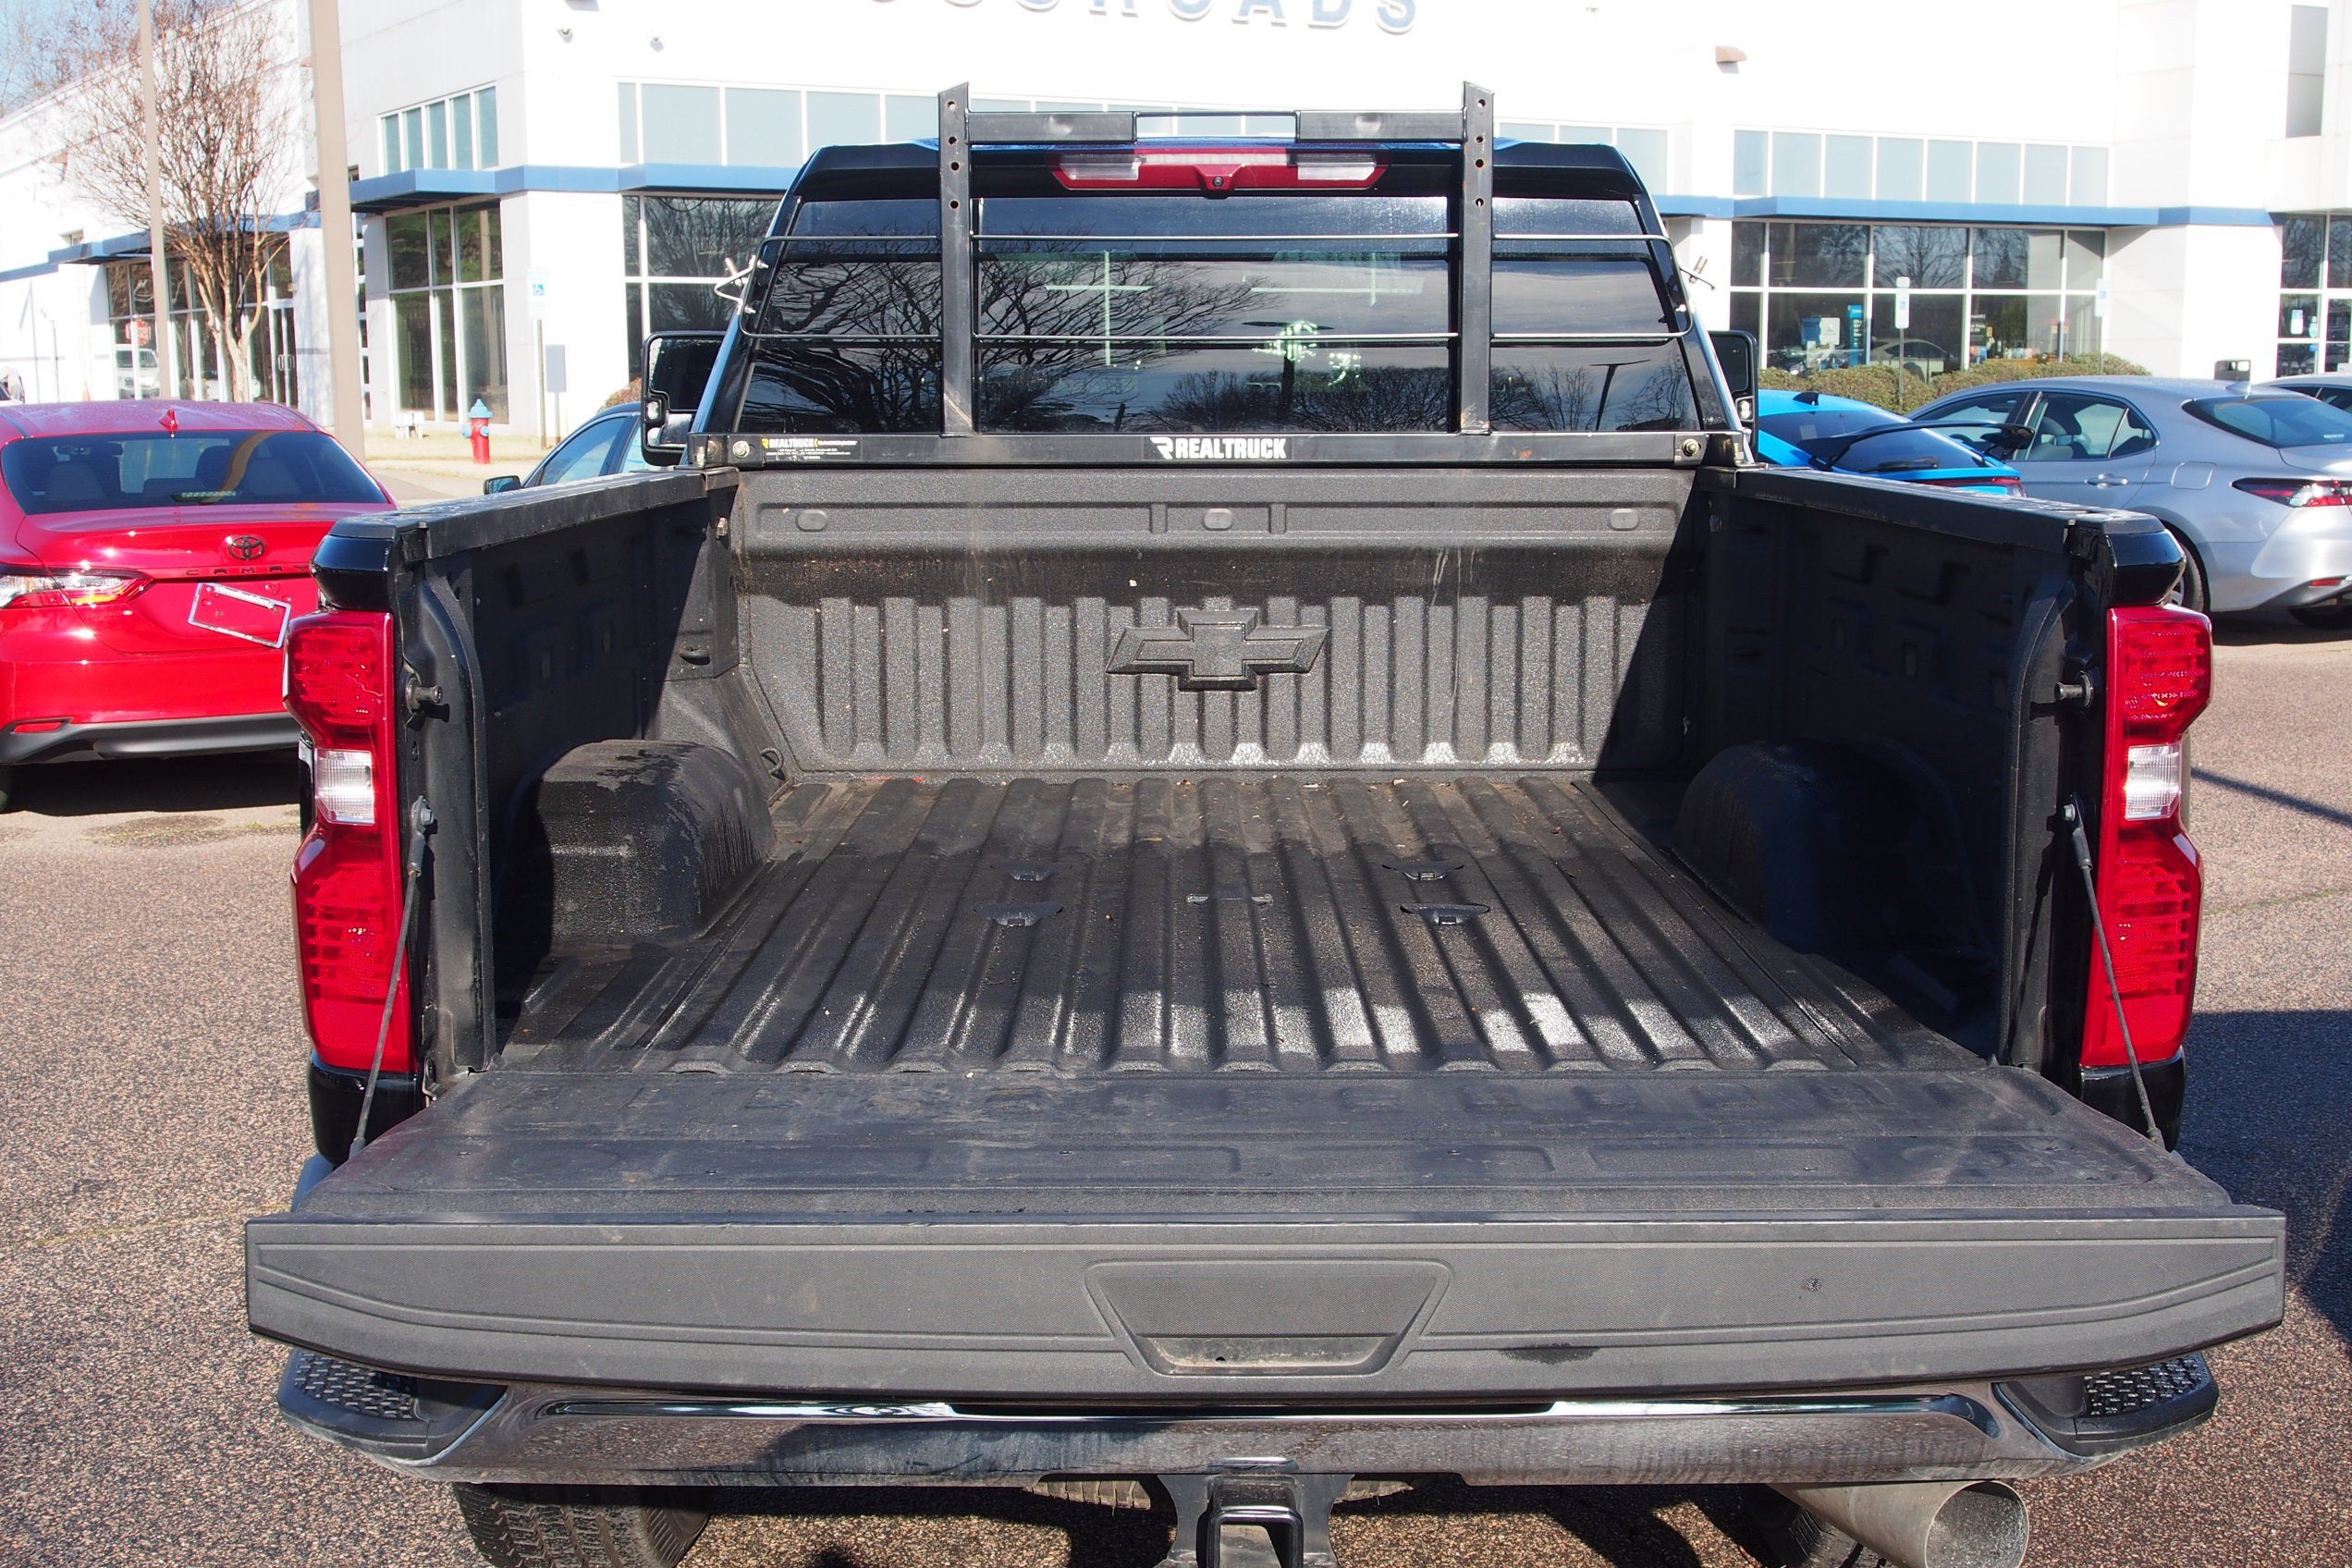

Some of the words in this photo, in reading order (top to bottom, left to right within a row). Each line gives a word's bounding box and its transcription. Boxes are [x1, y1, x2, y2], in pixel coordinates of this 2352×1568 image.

[768, 437, 815, 448] REALTRUCK
[1175, 437, 1286, 459] REALTRUCK
[185, 564, 310, 576] CAMRY
